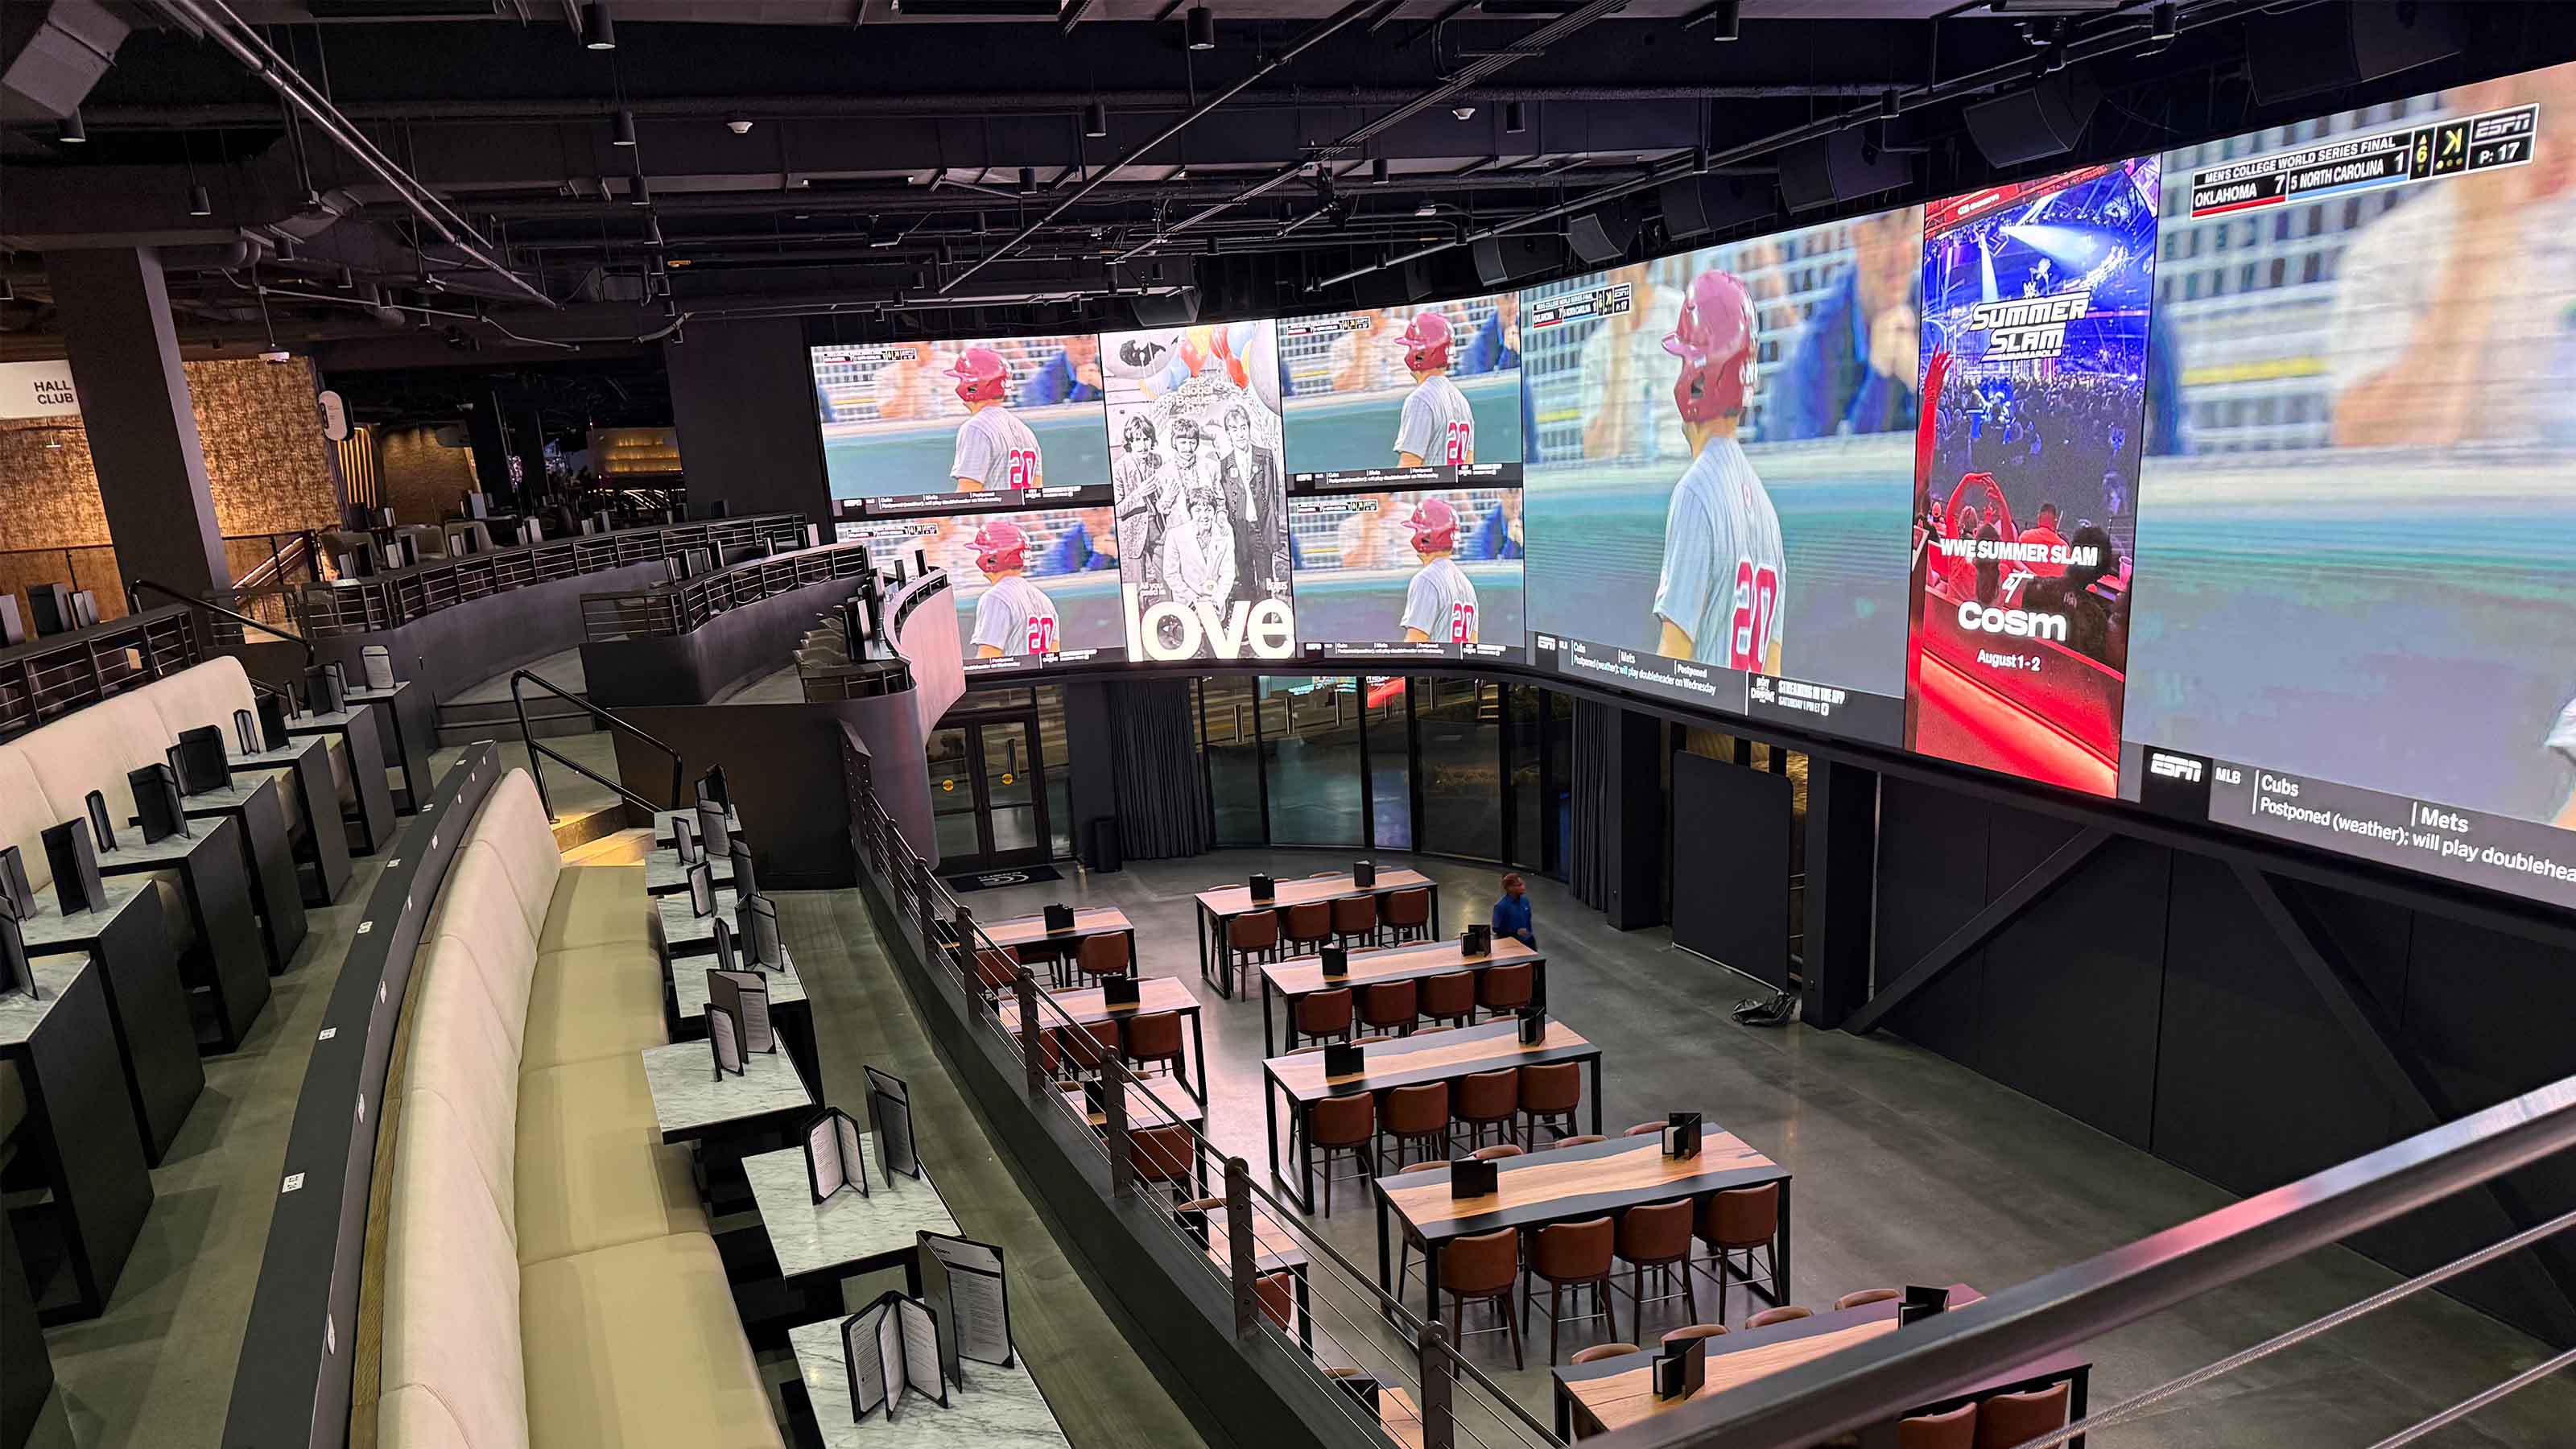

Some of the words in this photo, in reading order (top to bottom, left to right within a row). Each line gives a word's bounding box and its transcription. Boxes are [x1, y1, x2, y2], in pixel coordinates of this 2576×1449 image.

[2475, 113, 2531, 138] ESPN
[2232, 159, 2277, 179] COLLEGE
[2277, 151, 2316, 169] WORLD
[2318, 143, 2358, 162] SERIES
[2360, 136, 2396, 154] FINAL
[2416, 145, 2428, 161] 6
[2497, 141, 2520, 159] 17
[2290, 175, 2297, 189] 5
[2300, 168, 2333, 188] NORTH
[2334, 159, 2384, 181] CAROLINA
[2394, 151, 2405, 172] 1
[2194, 182, 2257, 207] OKLAHOMA
[2274, 175, 2286, 194] 7
[1969, 291, 2091, 331] SUMMER
[1986, 322, 2066, 354] SLAM
[34, 380, 71, 392] HALL
[37, 393, 73, 404] CLUB
[1446, 419, 1472, 465] 20
[1008, 447, 1038, 489] 20
[1940, 539, 1976, 558] WWE
[1977, 541, 2049, 562] SUMMER
[2050, 544, 2099, 566] SLAM
[1122, 583, 1295, 663] love
[1450, 601, 1476, 644] 20
[1729, 555, 1780, 673] 20
[1027, 614, 1055, 654] 20
[1620, 650, 1636, 663] Mets
[1677, 663, 1707, 678] Postponed
[1977, 649, 2017, 668] August
[1639, 669, 1674, 685] doubleheader
[1674, 678, 1683, 687] on
[1683, 677, 1716, 696] Wednesday
[2150, 753, 2203, 782] ESPN
[2215, 767, 2241, 784] MLB
[2260, 774, 2299, 797] Cubs
[2260, 796, 2331, 826] Postponed
[2332, 813, 2409, 846] (weather);
[2413, 832, 2440, 851] will
[2442, 839, 2479, 862] play
[2421, 806, 2469, 832] Mets
